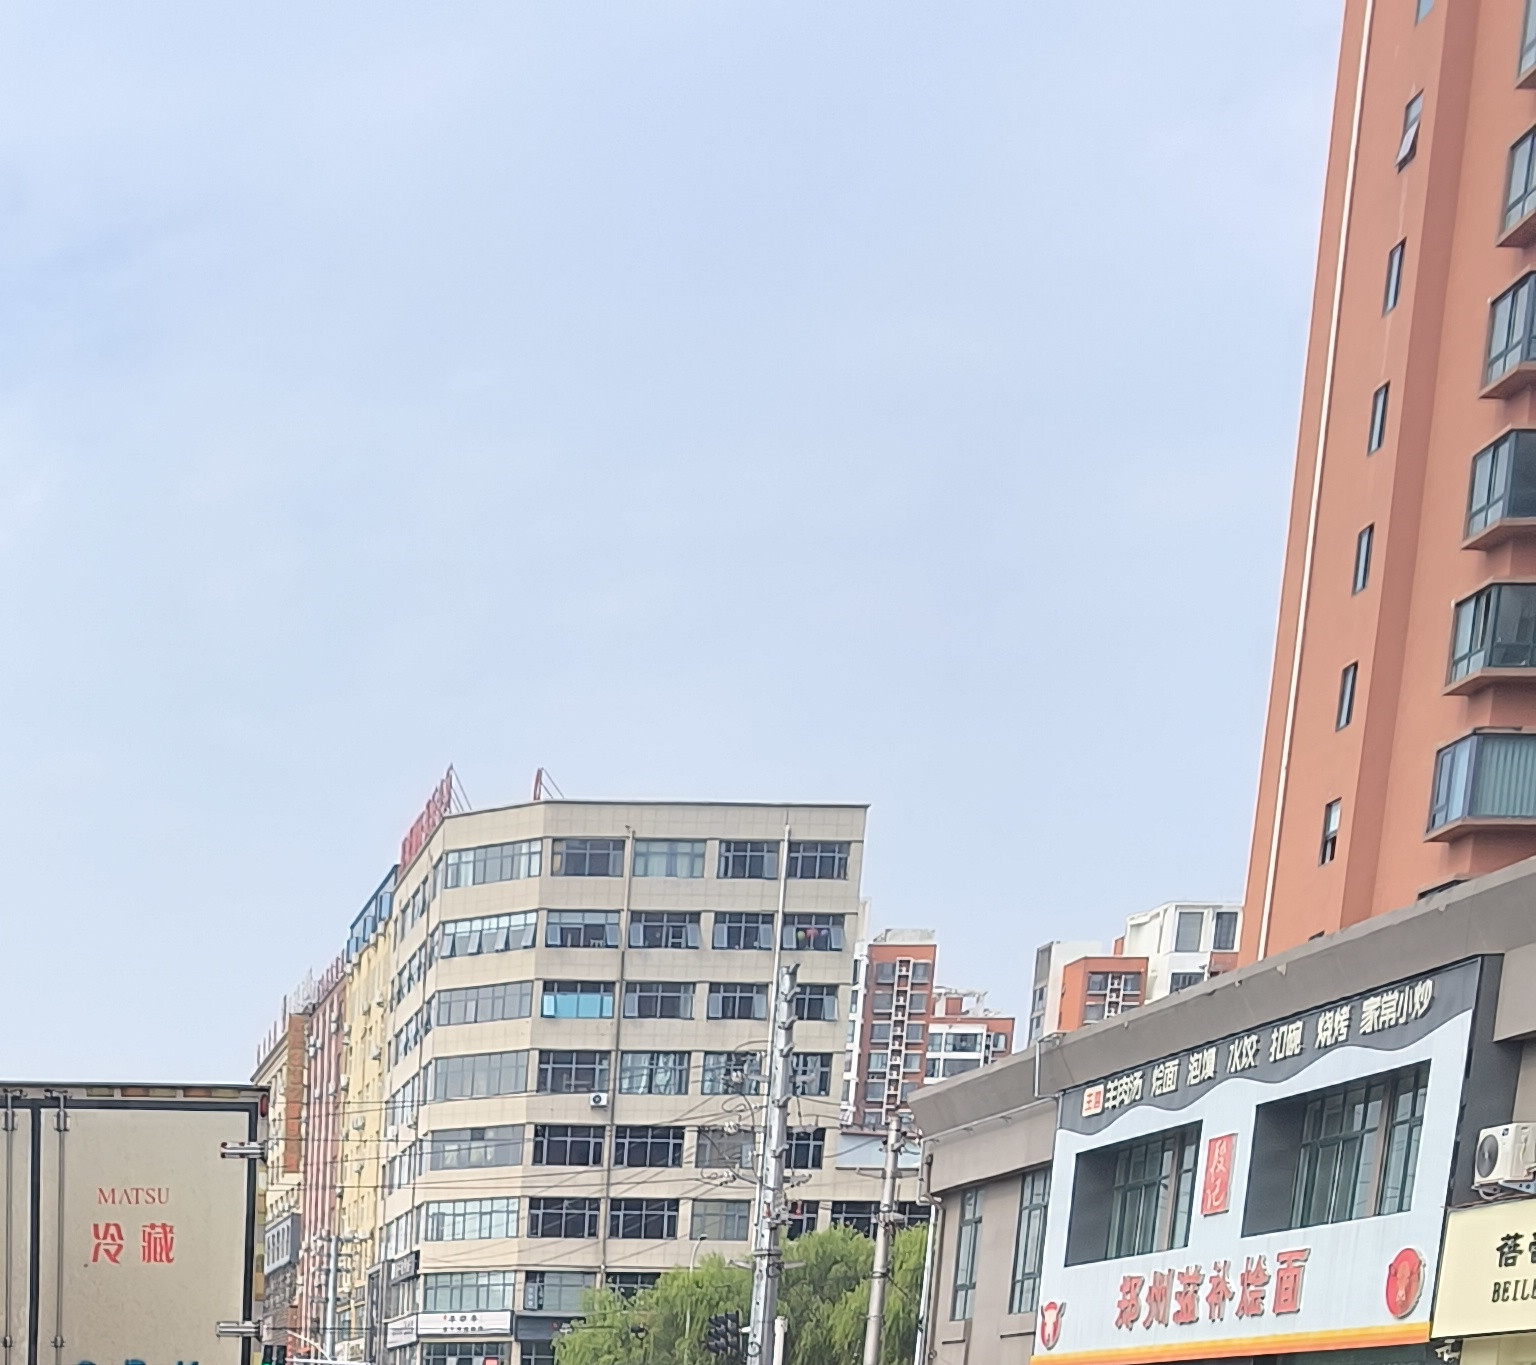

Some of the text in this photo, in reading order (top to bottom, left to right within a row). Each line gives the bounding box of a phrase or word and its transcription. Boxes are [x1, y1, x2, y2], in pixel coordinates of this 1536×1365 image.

[1104, 1071, 1144, 1110] 羊肉汤
[1150, 1059, 1180, 1097] 烩面
[1226, 1034, 1260, 1074] 水饺
[1269, 1020, 1304, 1062] 扣碗
[1315, 1004, 1351, 1048] 烧烤
[1359, 979, 1434, 1035] 家常小炒
[97, 1187, 170, 1205] MATSU
[1115, 1248, 1311, 1331] 郑州滋补烩面
